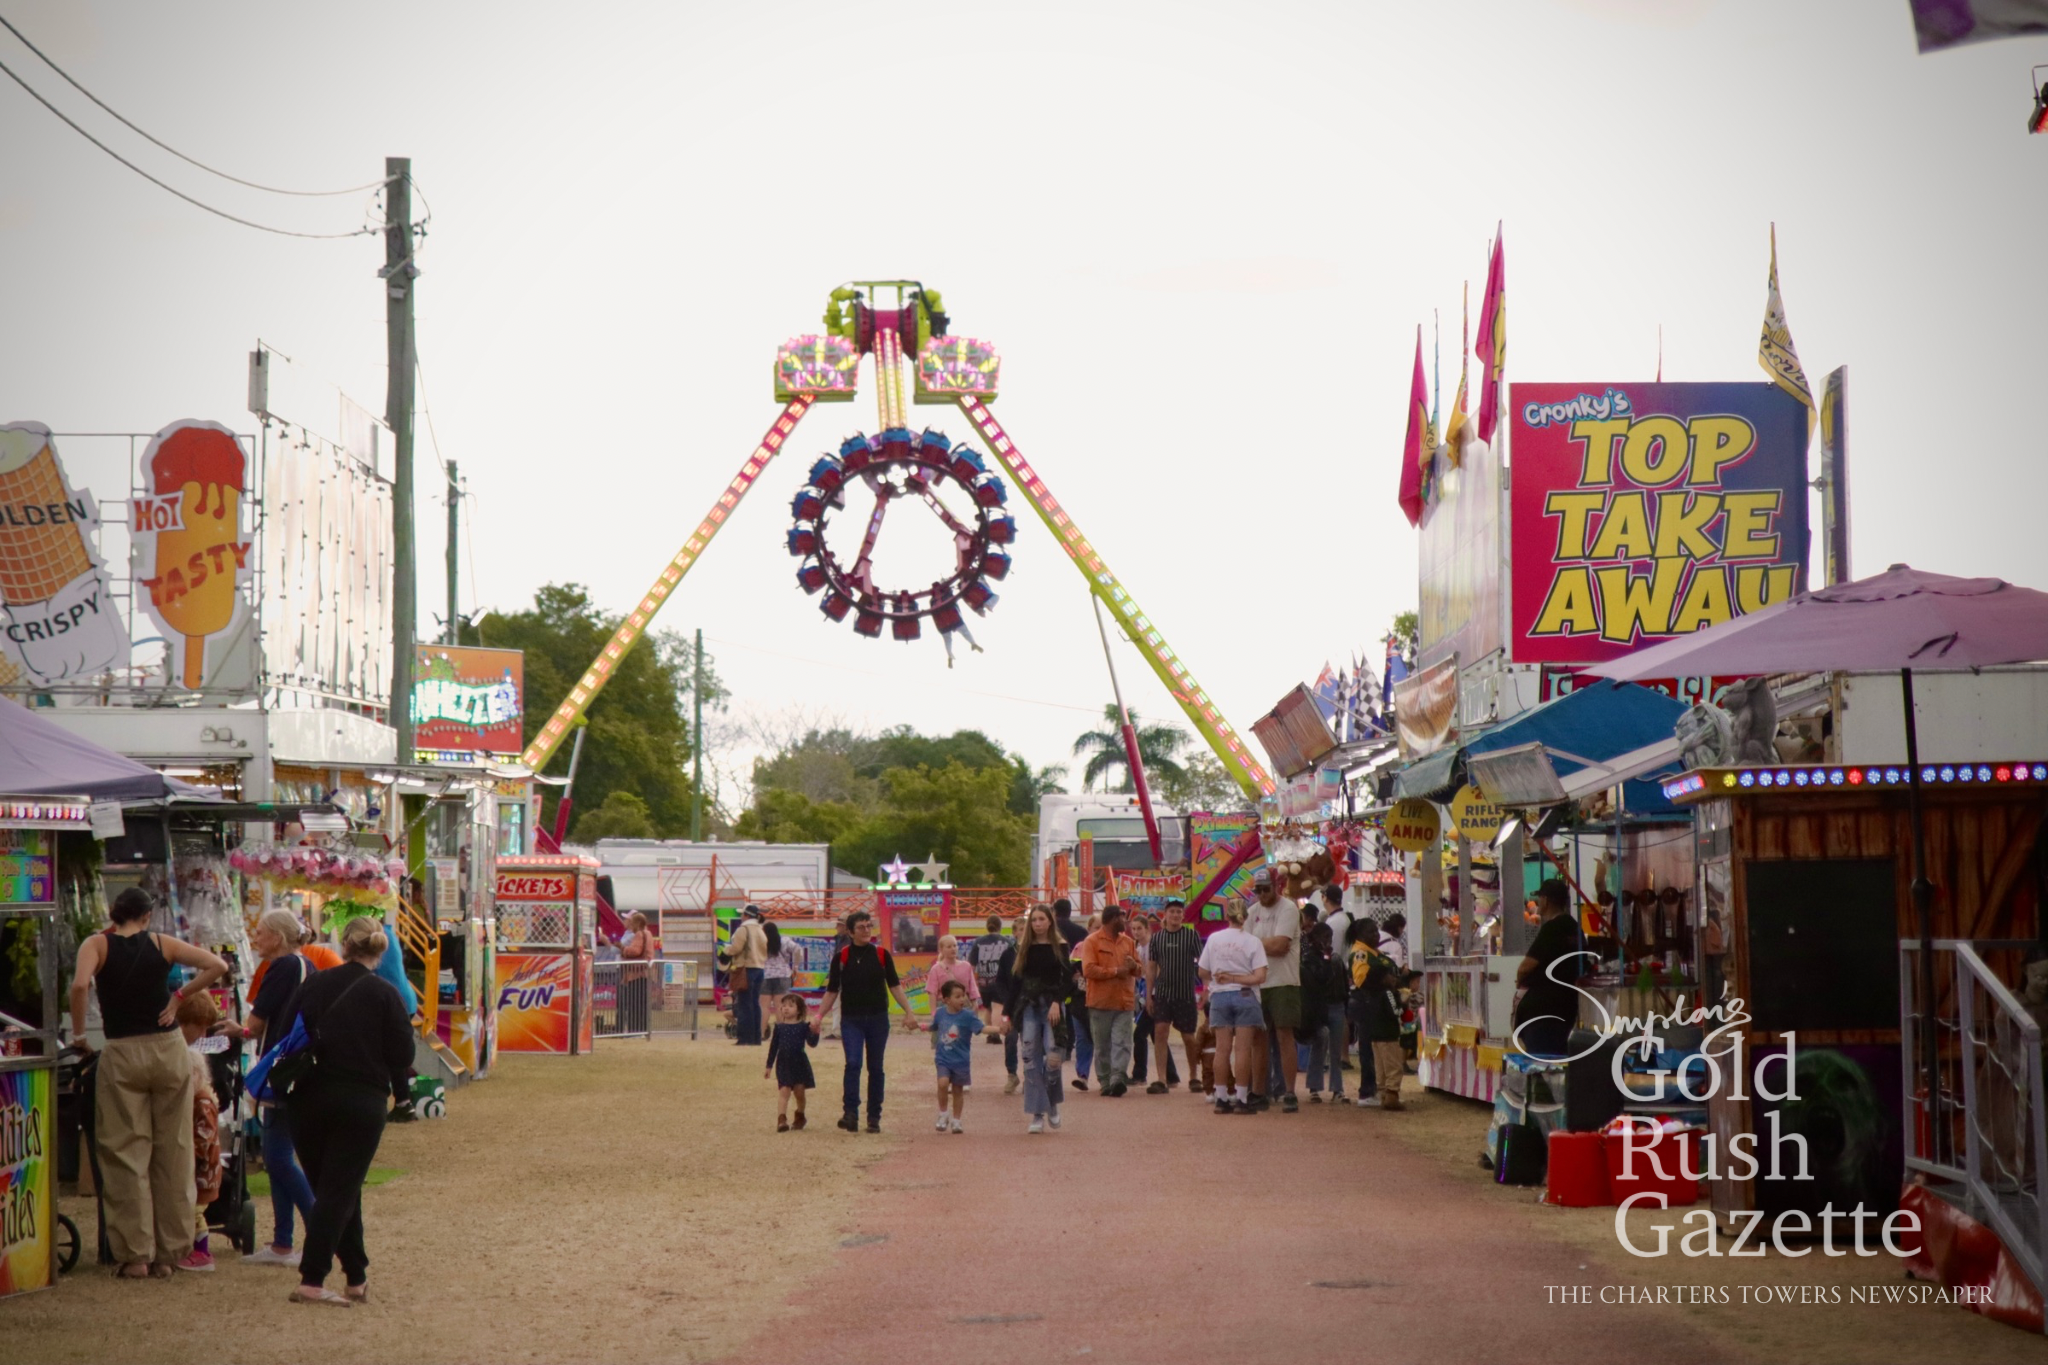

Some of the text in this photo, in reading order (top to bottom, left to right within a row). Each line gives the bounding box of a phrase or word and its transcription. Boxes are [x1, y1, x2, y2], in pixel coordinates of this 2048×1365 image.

[1524, 388, 1632, 427] Cronky's
[1568, 414, 1757, 488] TOP
[134, 496, 179, 532] HOT
[1543, 488, 1783, 563] TAKE
[142, 542, 251, 606] TASTY
[7, 592, 99, 643] CRISPY
[1400, 804, 1424, 819] LIVE
[1465, 804, 1501, 816] RIFLE
[1392, 824, 1434, 841] AMMO
[885, 893, 944, 906] TICKETS
[1118, 873, 1186, 899] EXTREME
[497, 985, 555, 1011] FUN
